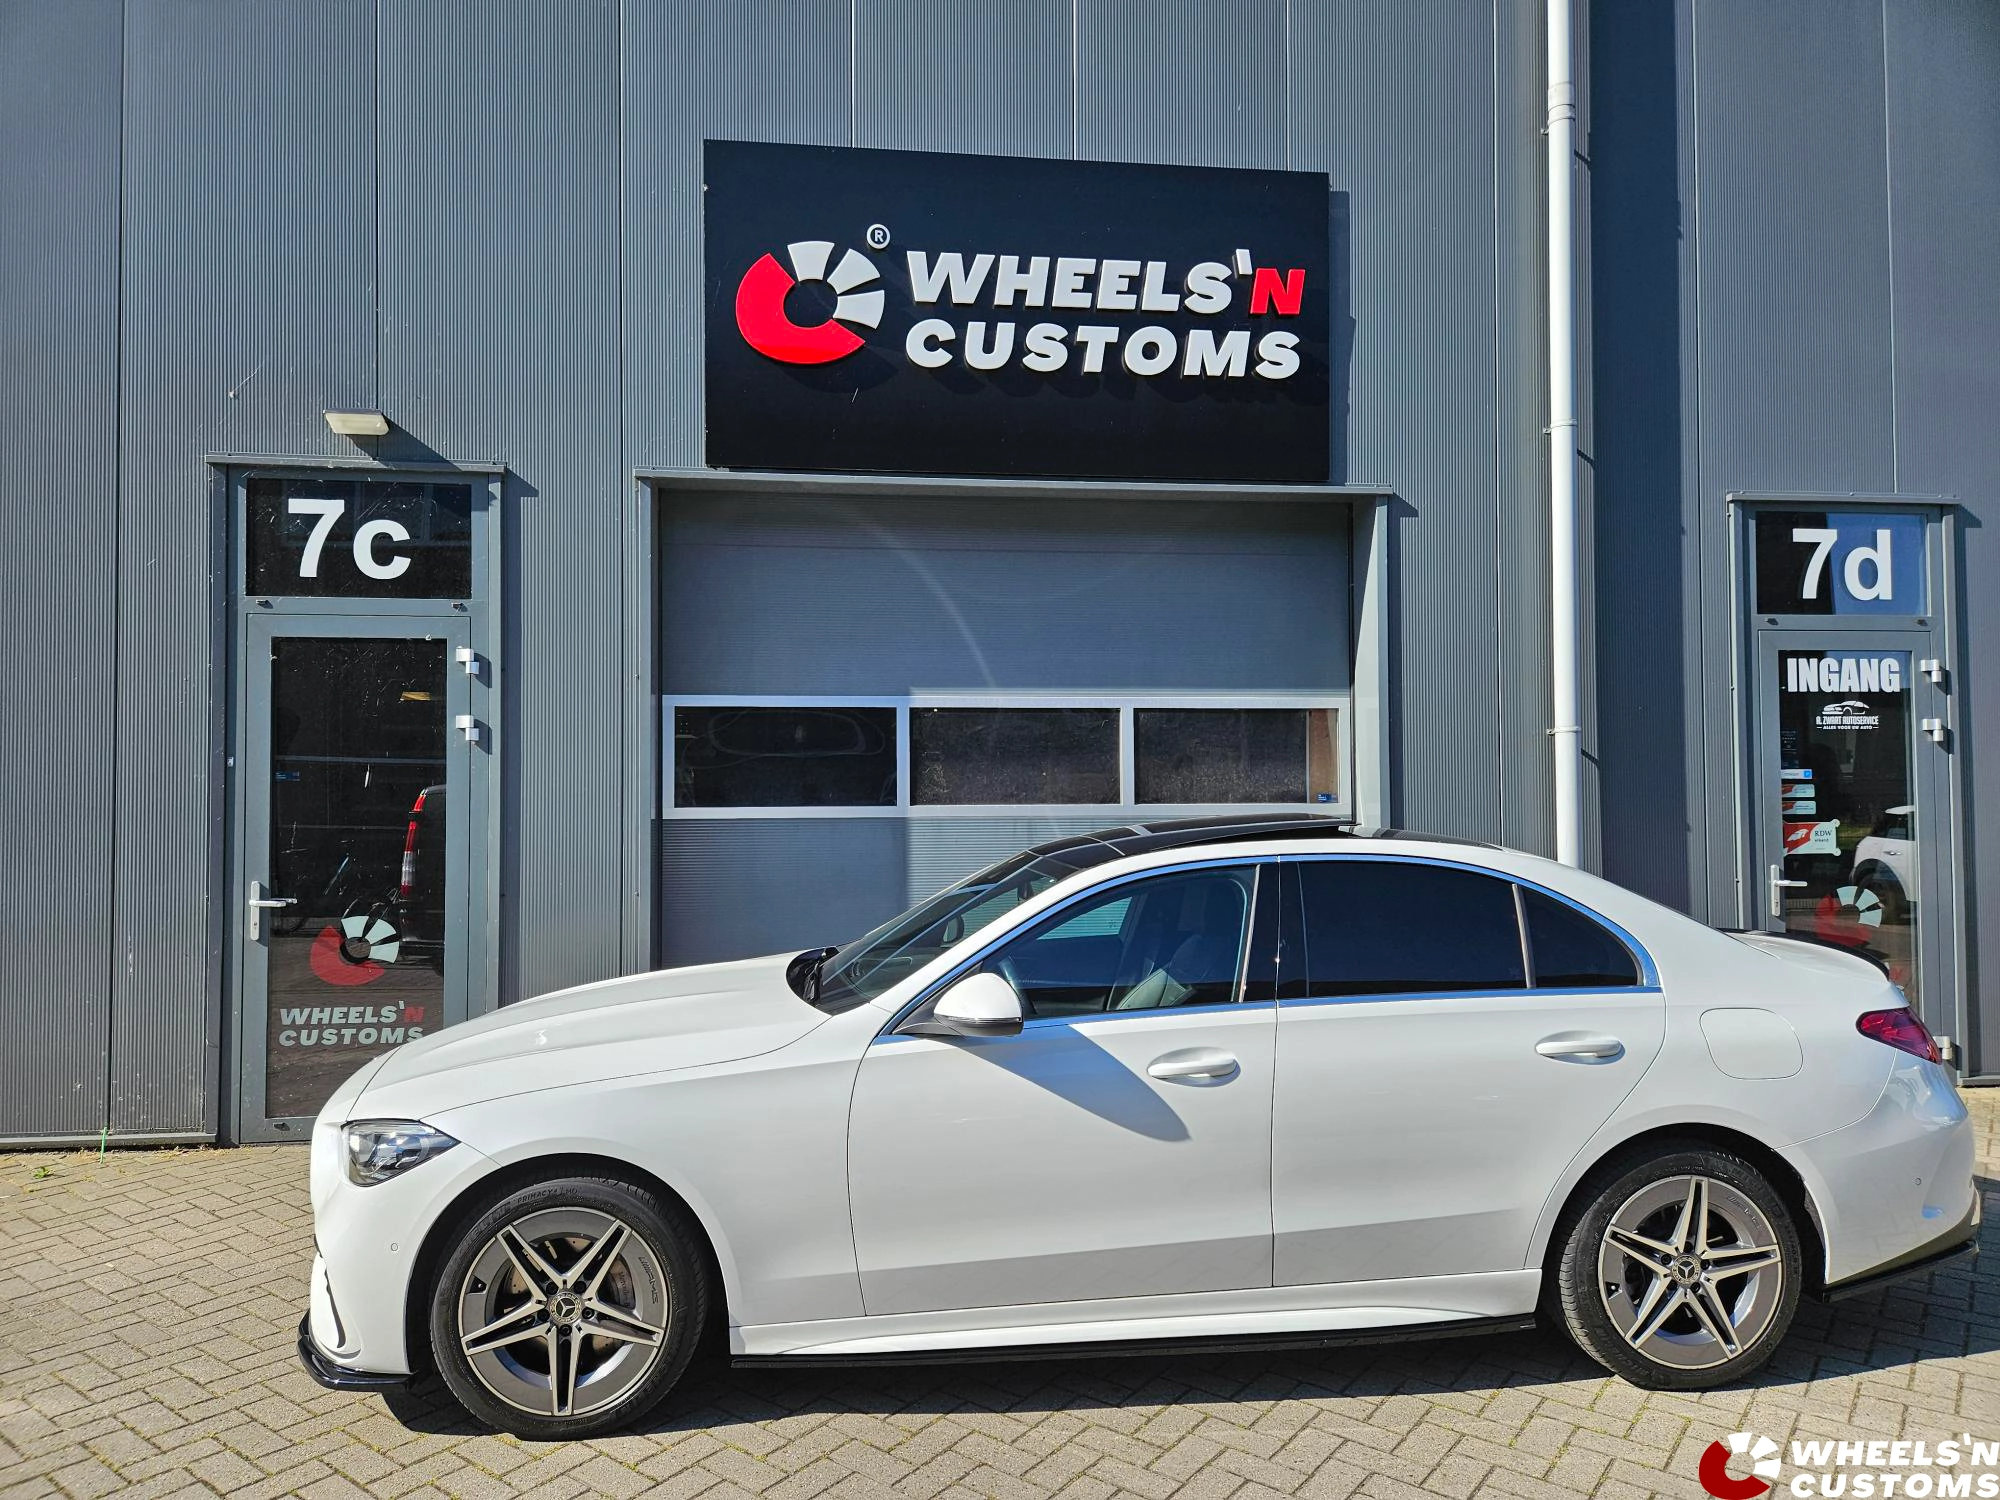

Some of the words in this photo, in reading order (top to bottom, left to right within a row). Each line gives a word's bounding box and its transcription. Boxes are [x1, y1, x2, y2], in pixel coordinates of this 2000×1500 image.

[906, 318, 1301, 380] CUSTOMS
[288, 498, 412, 580] 7c
[1792, 528, 1893, 601] 7d
[1787, 657, 1901, 693] INGANG
[1823, 716, 1841, 725] ZWART
[1843, 716, 1879, 725] AUTOSERVICE
[278, 1026, 423, 1047] CUSTOMS
[517, 1188, 553, 1205] PRIMACY
